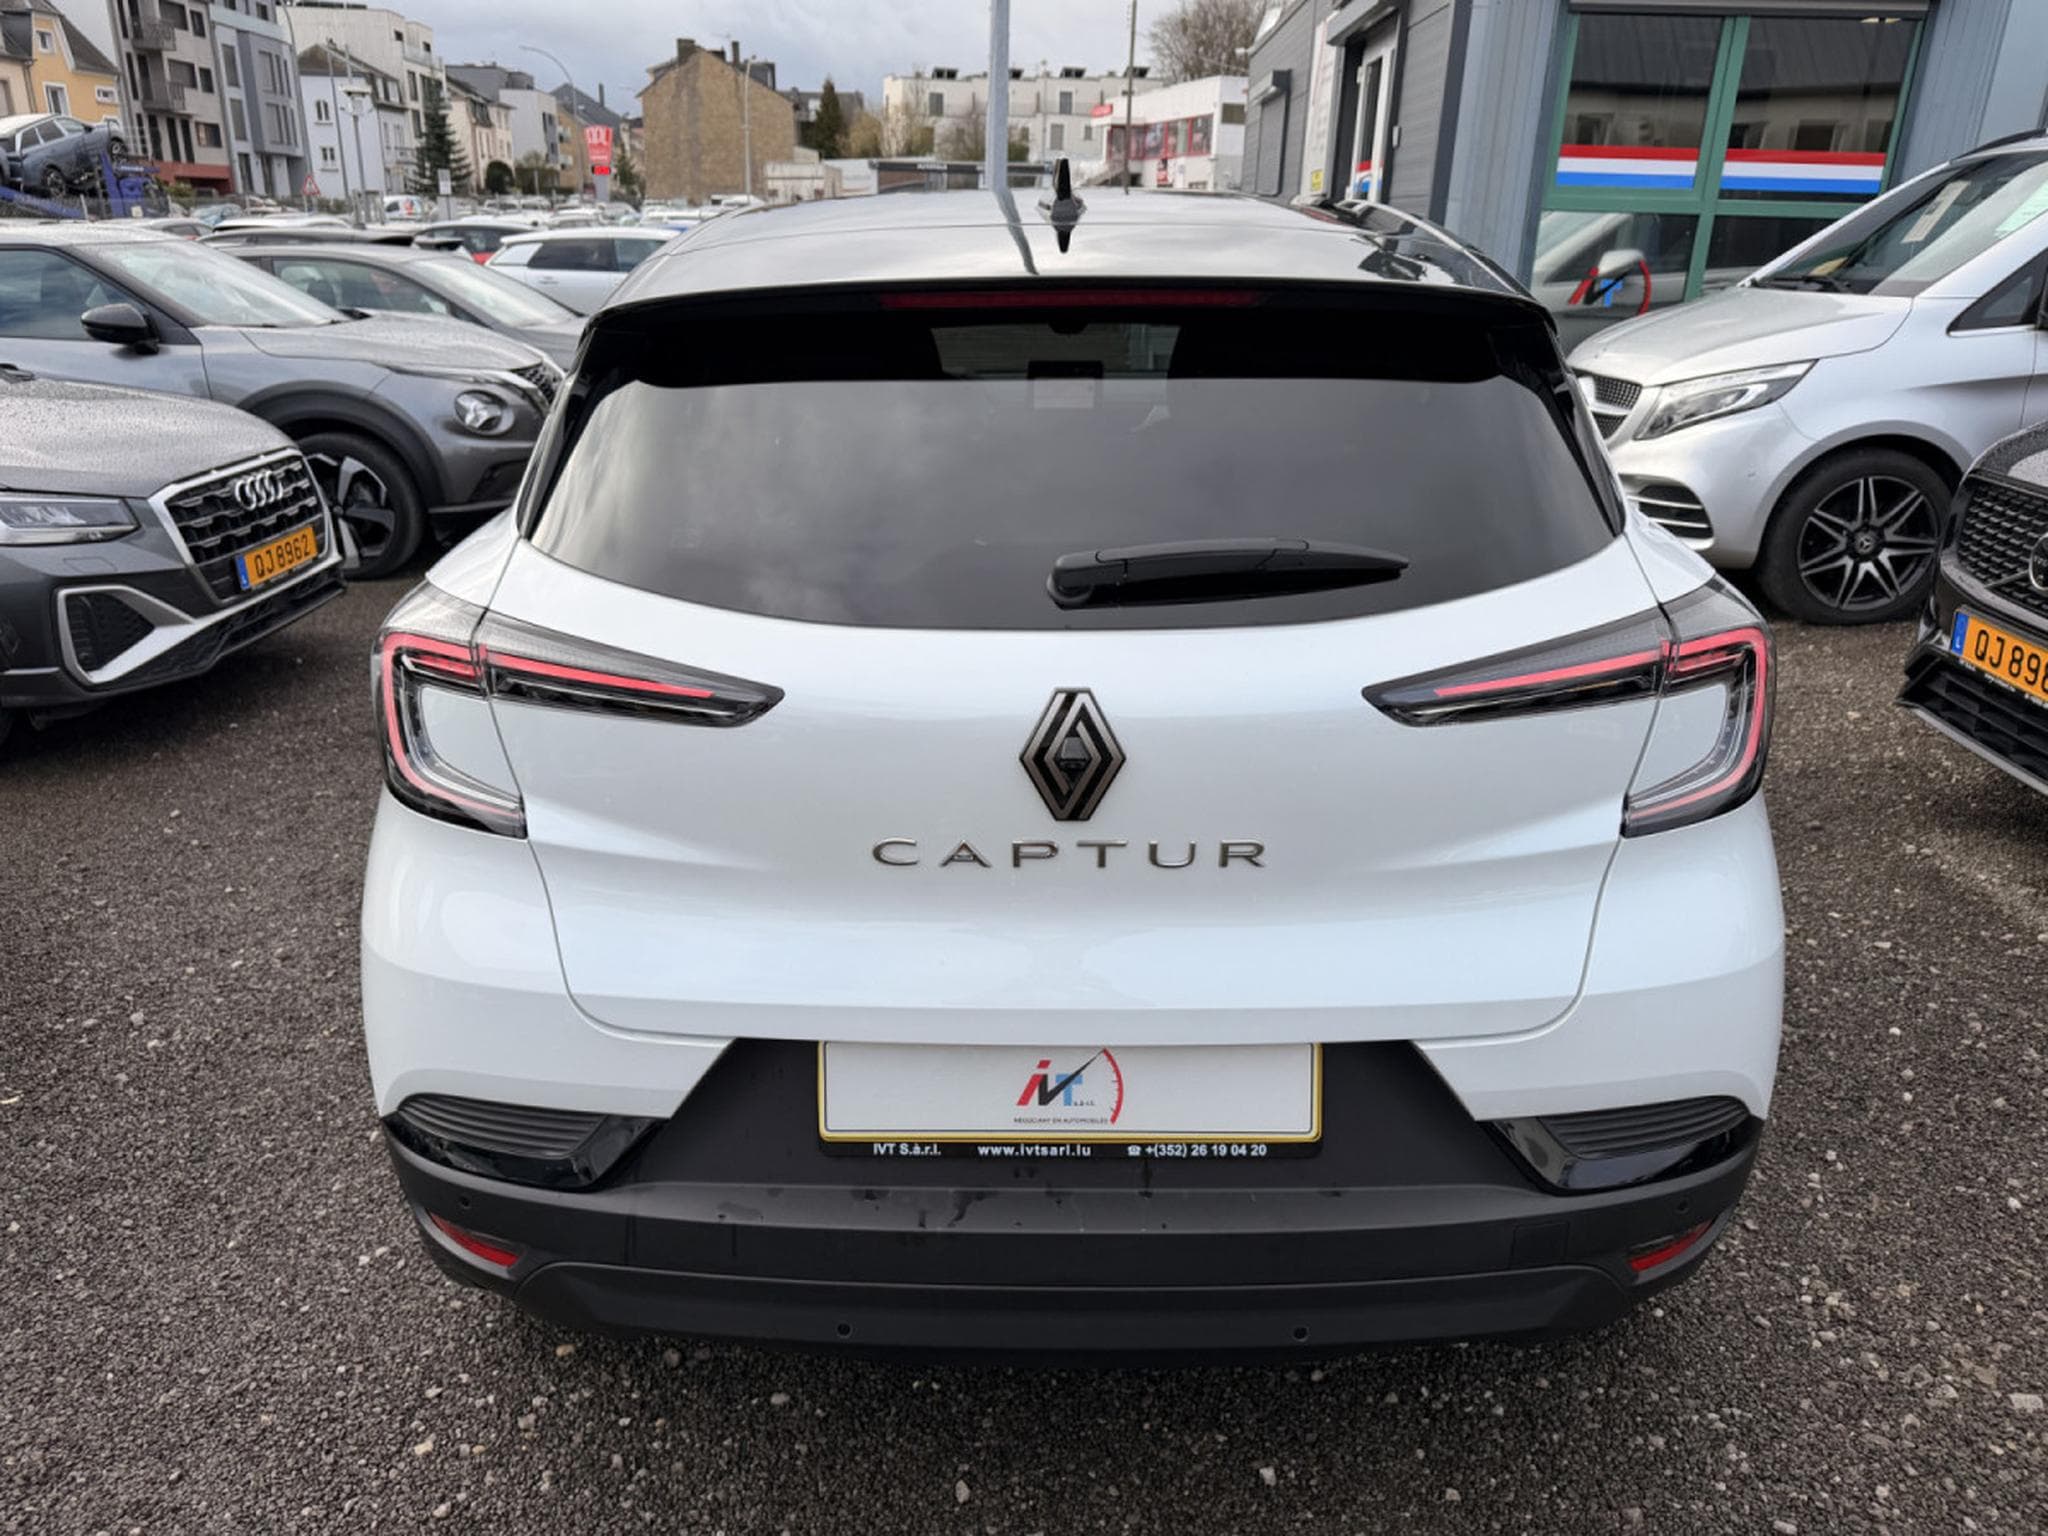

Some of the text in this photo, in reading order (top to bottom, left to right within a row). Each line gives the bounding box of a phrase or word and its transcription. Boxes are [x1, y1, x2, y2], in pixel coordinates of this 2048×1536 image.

[872, 837, 1266, 869] CAPTUR
[873, 1143, 896, 1155] IVT
[977, 1143, 1091, 1156] www.ivtsarl.lu
[1145, 1144, 1267, 1157] +(352) 26 19 04 20
